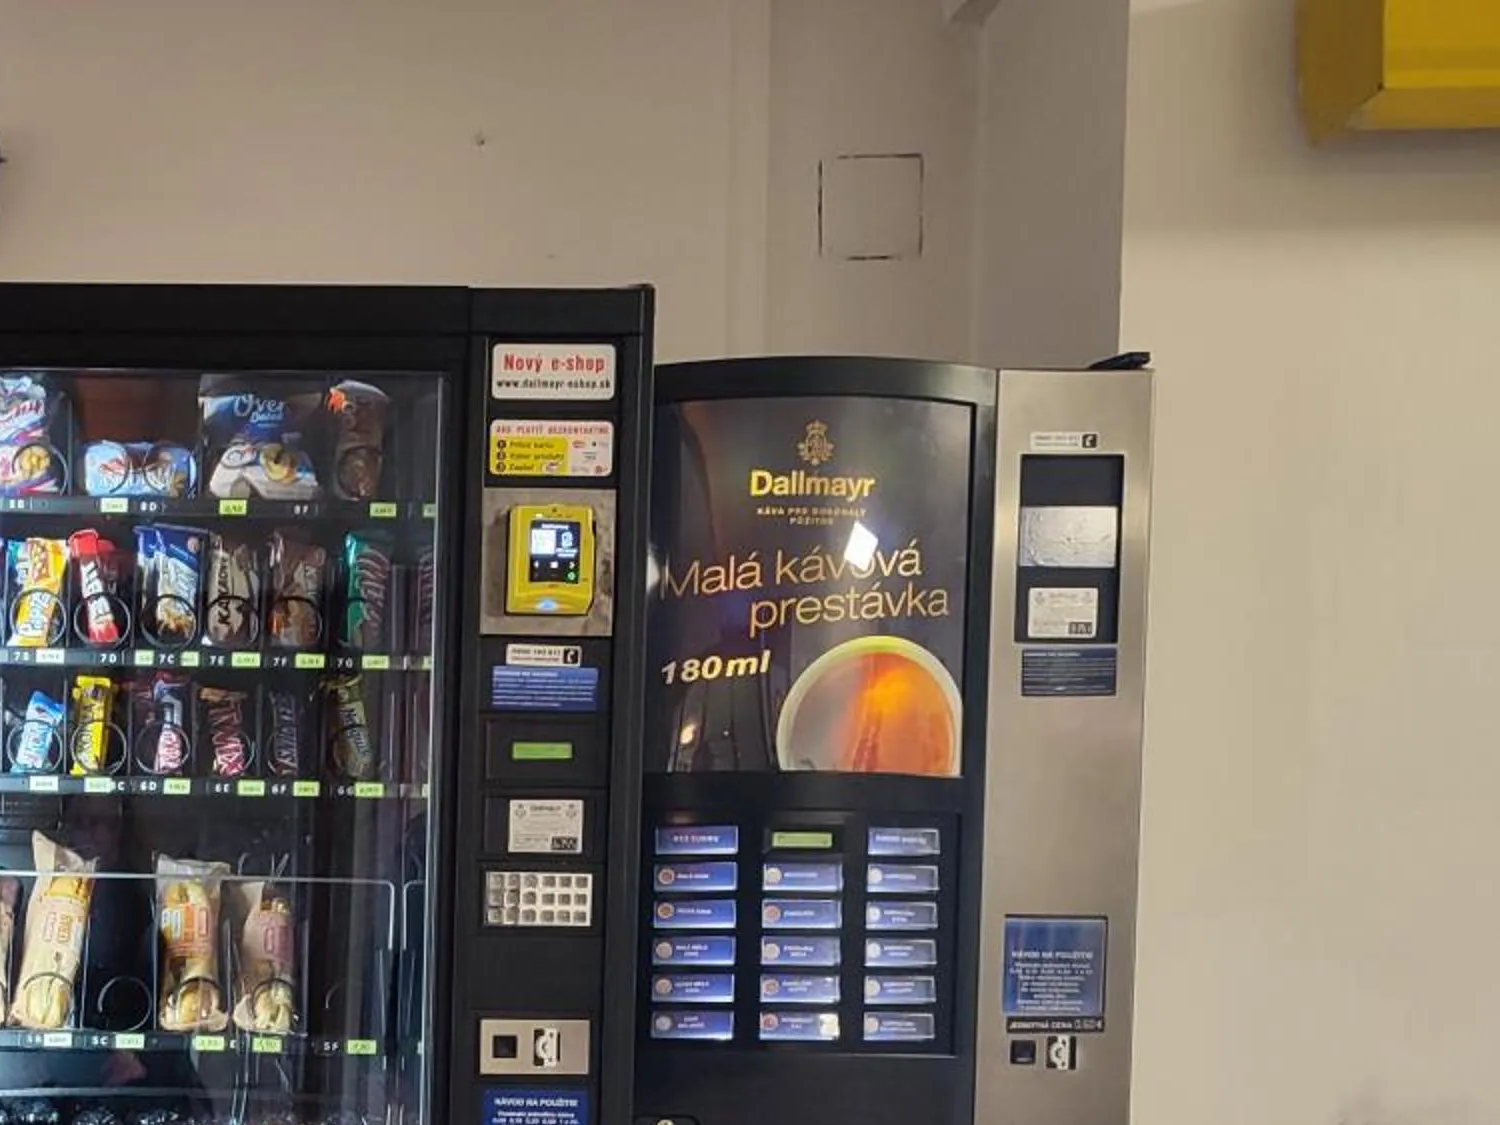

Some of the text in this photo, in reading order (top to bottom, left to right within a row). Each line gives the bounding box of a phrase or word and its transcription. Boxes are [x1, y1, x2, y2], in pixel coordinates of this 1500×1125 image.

[503, 353, 605, 374] Nový e-shop
[750, 469, 875, 502] Dallmayr
[660, 538, 922, 599] Malá kávová
[749, 580, 949, 639] prestávka
